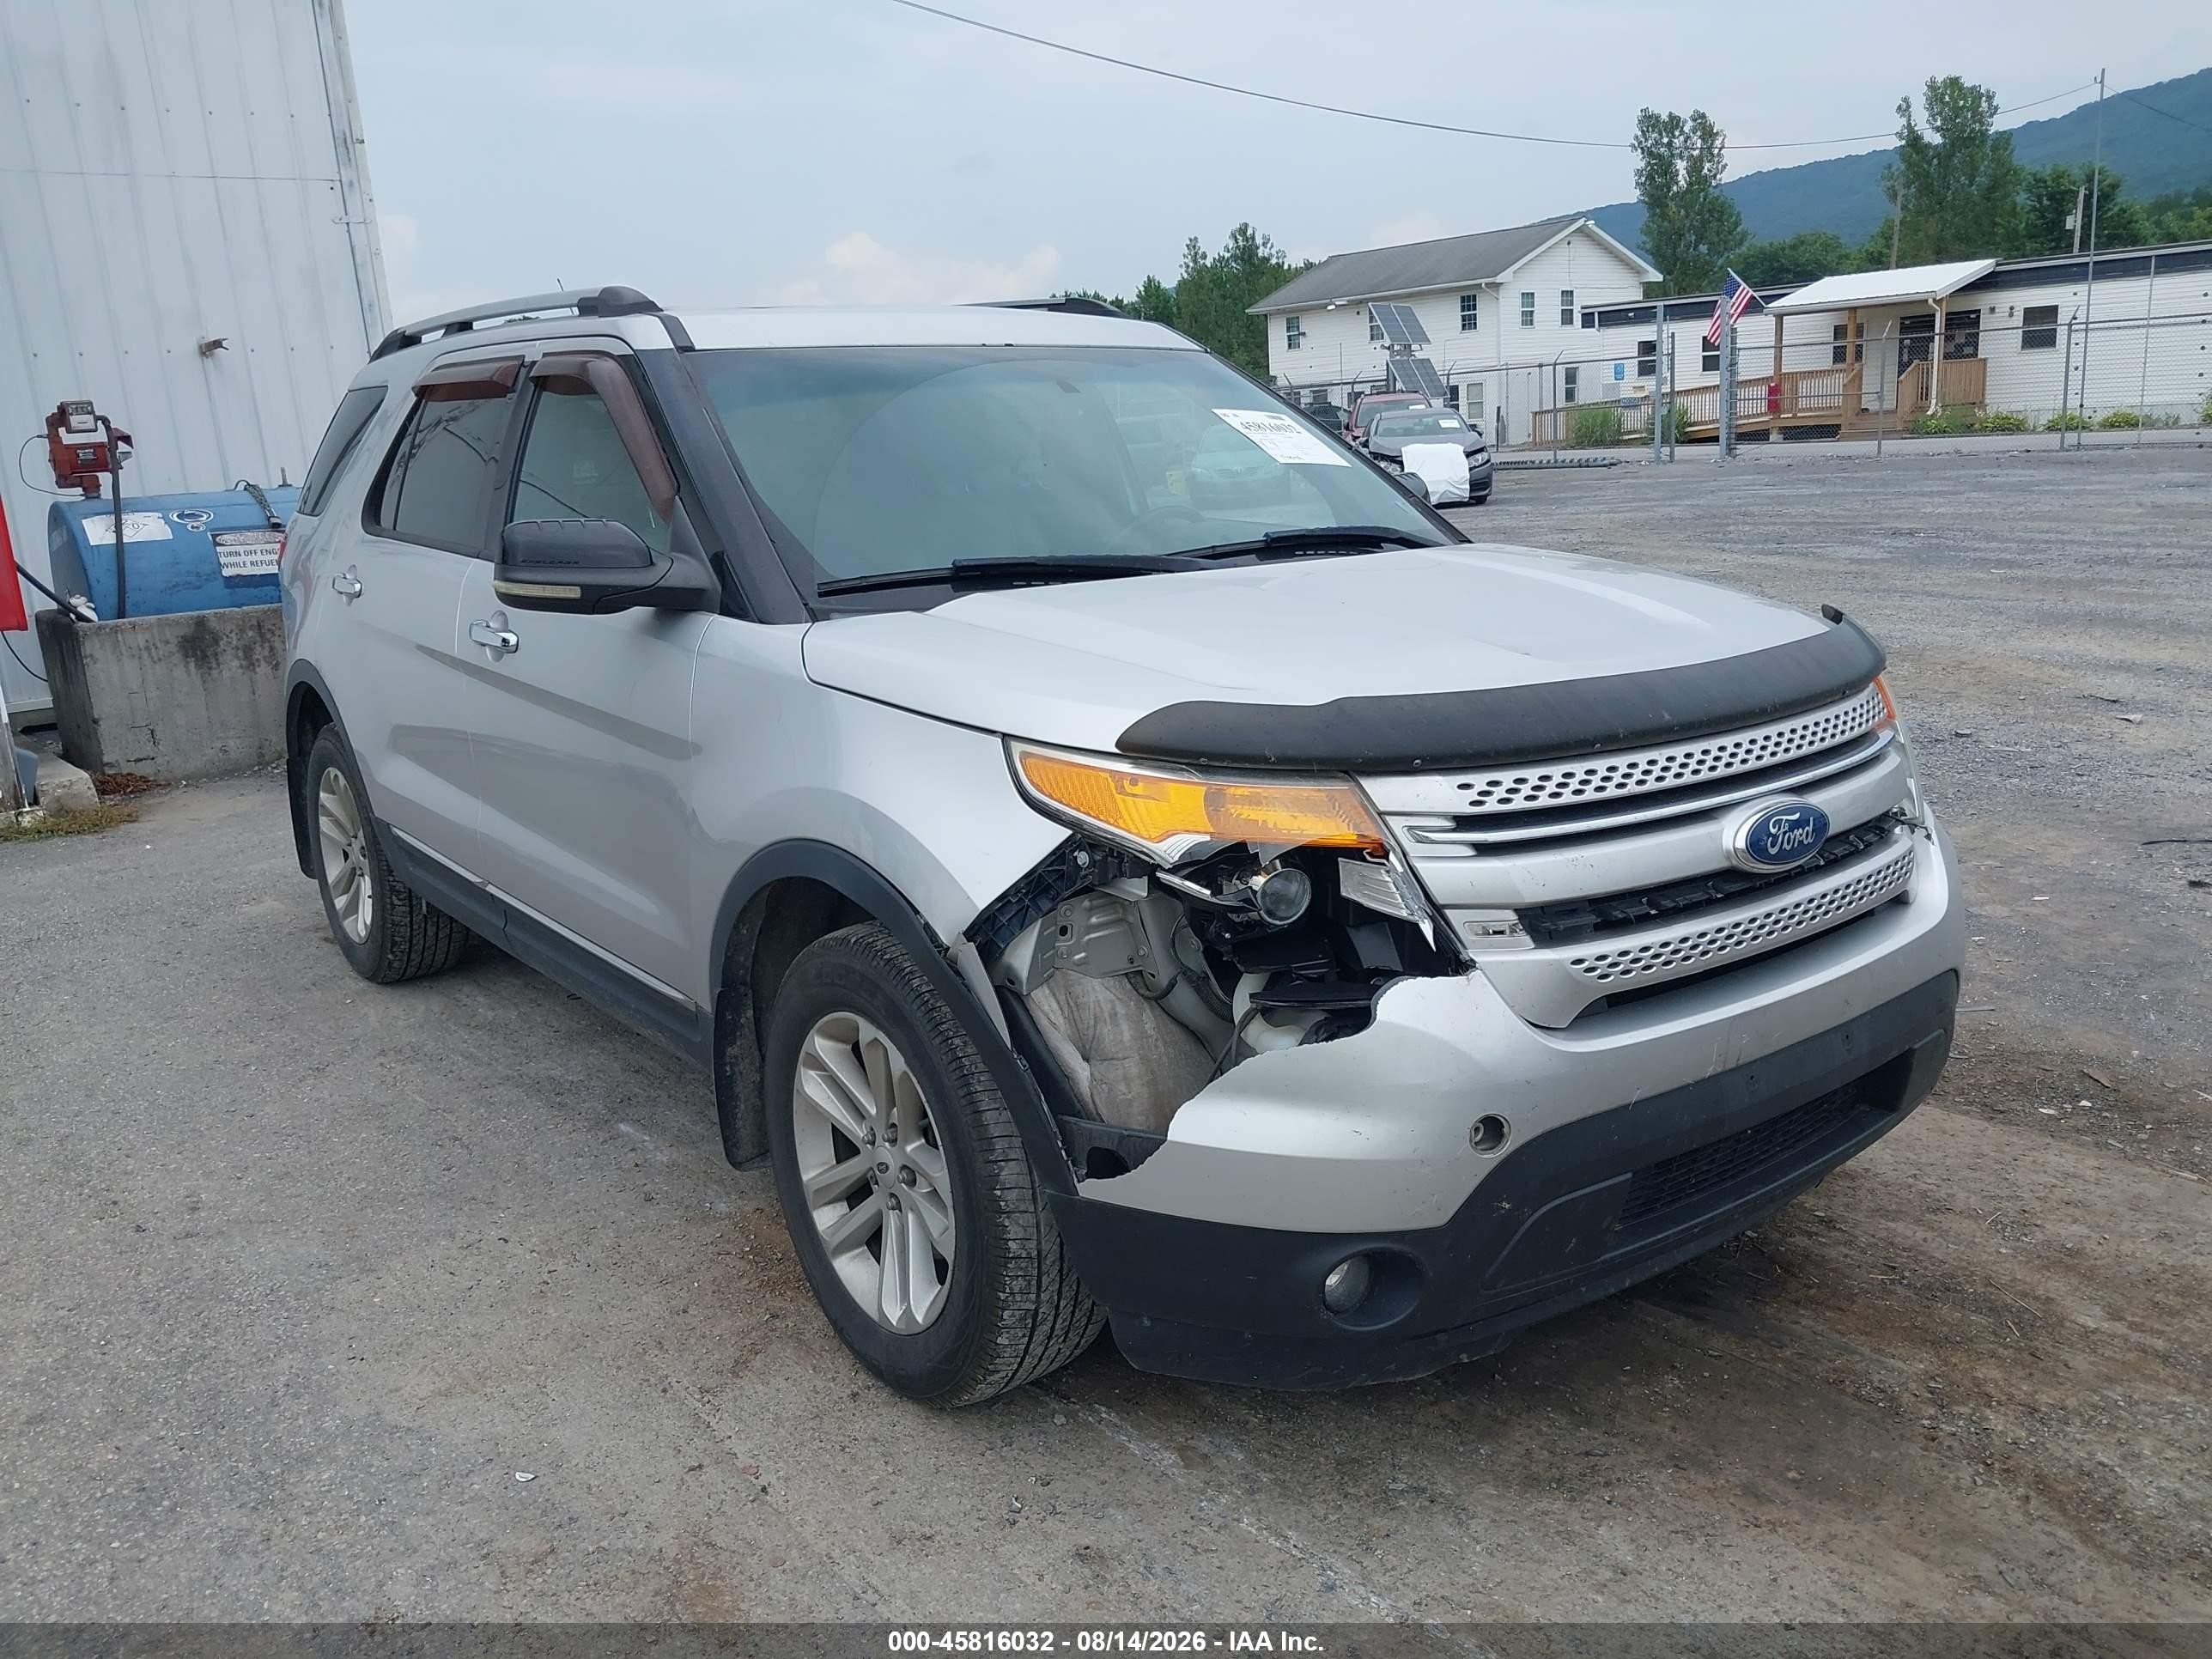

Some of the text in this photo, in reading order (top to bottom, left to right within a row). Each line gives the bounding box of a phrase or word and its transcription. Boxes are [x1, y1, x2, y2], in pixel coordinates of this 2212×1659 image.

[243, 549, 259, 557] OFF
[259, 548, 280, 556] ENG
[221, 561, 248, 569] WHILE
[1766, 811, 1817, 855] Ford
